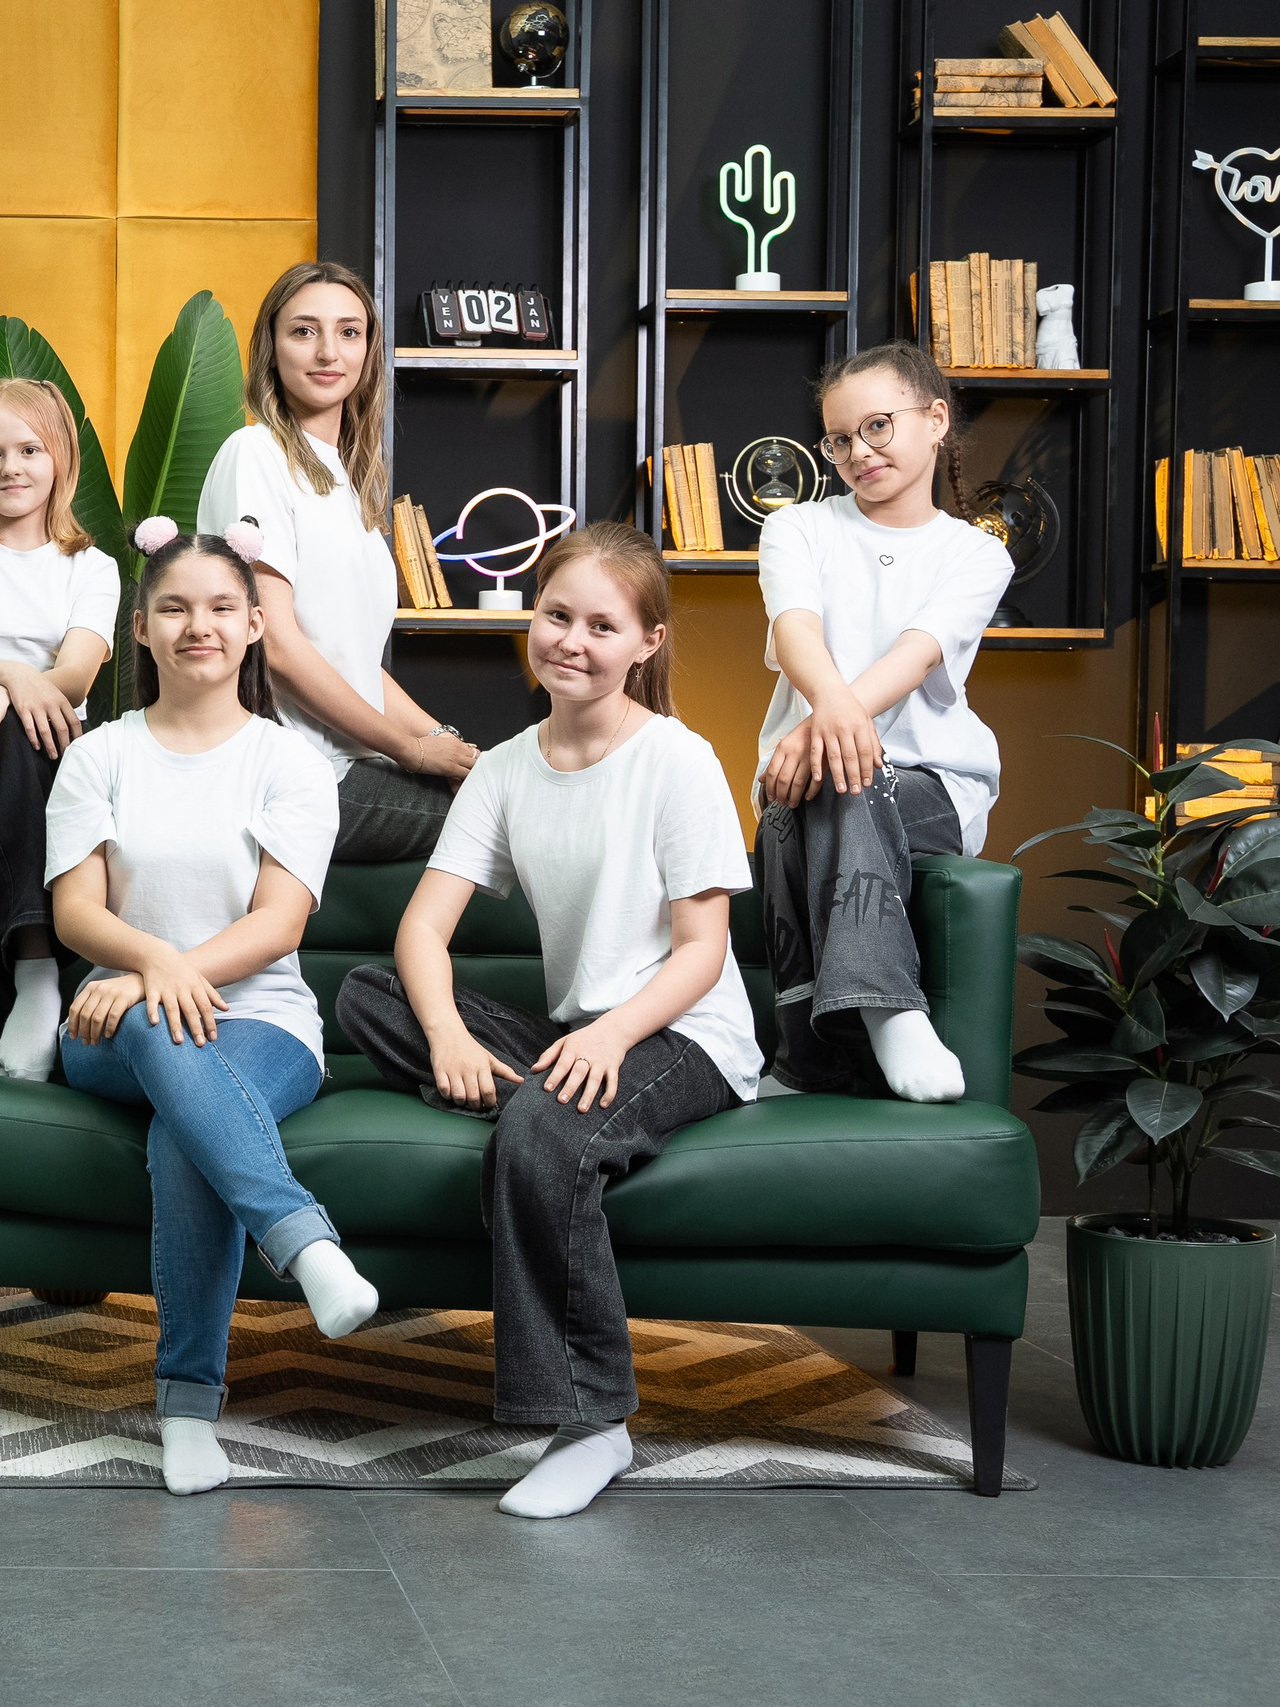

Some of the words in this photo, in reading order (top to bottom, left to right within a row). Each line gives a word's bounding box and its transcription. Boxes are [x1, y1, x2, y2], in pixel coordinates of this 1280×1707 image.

[439, 295, 453, 328] VEN
[465, 295, 513, 325] 02
[527, 297, 541, 328] JAN
